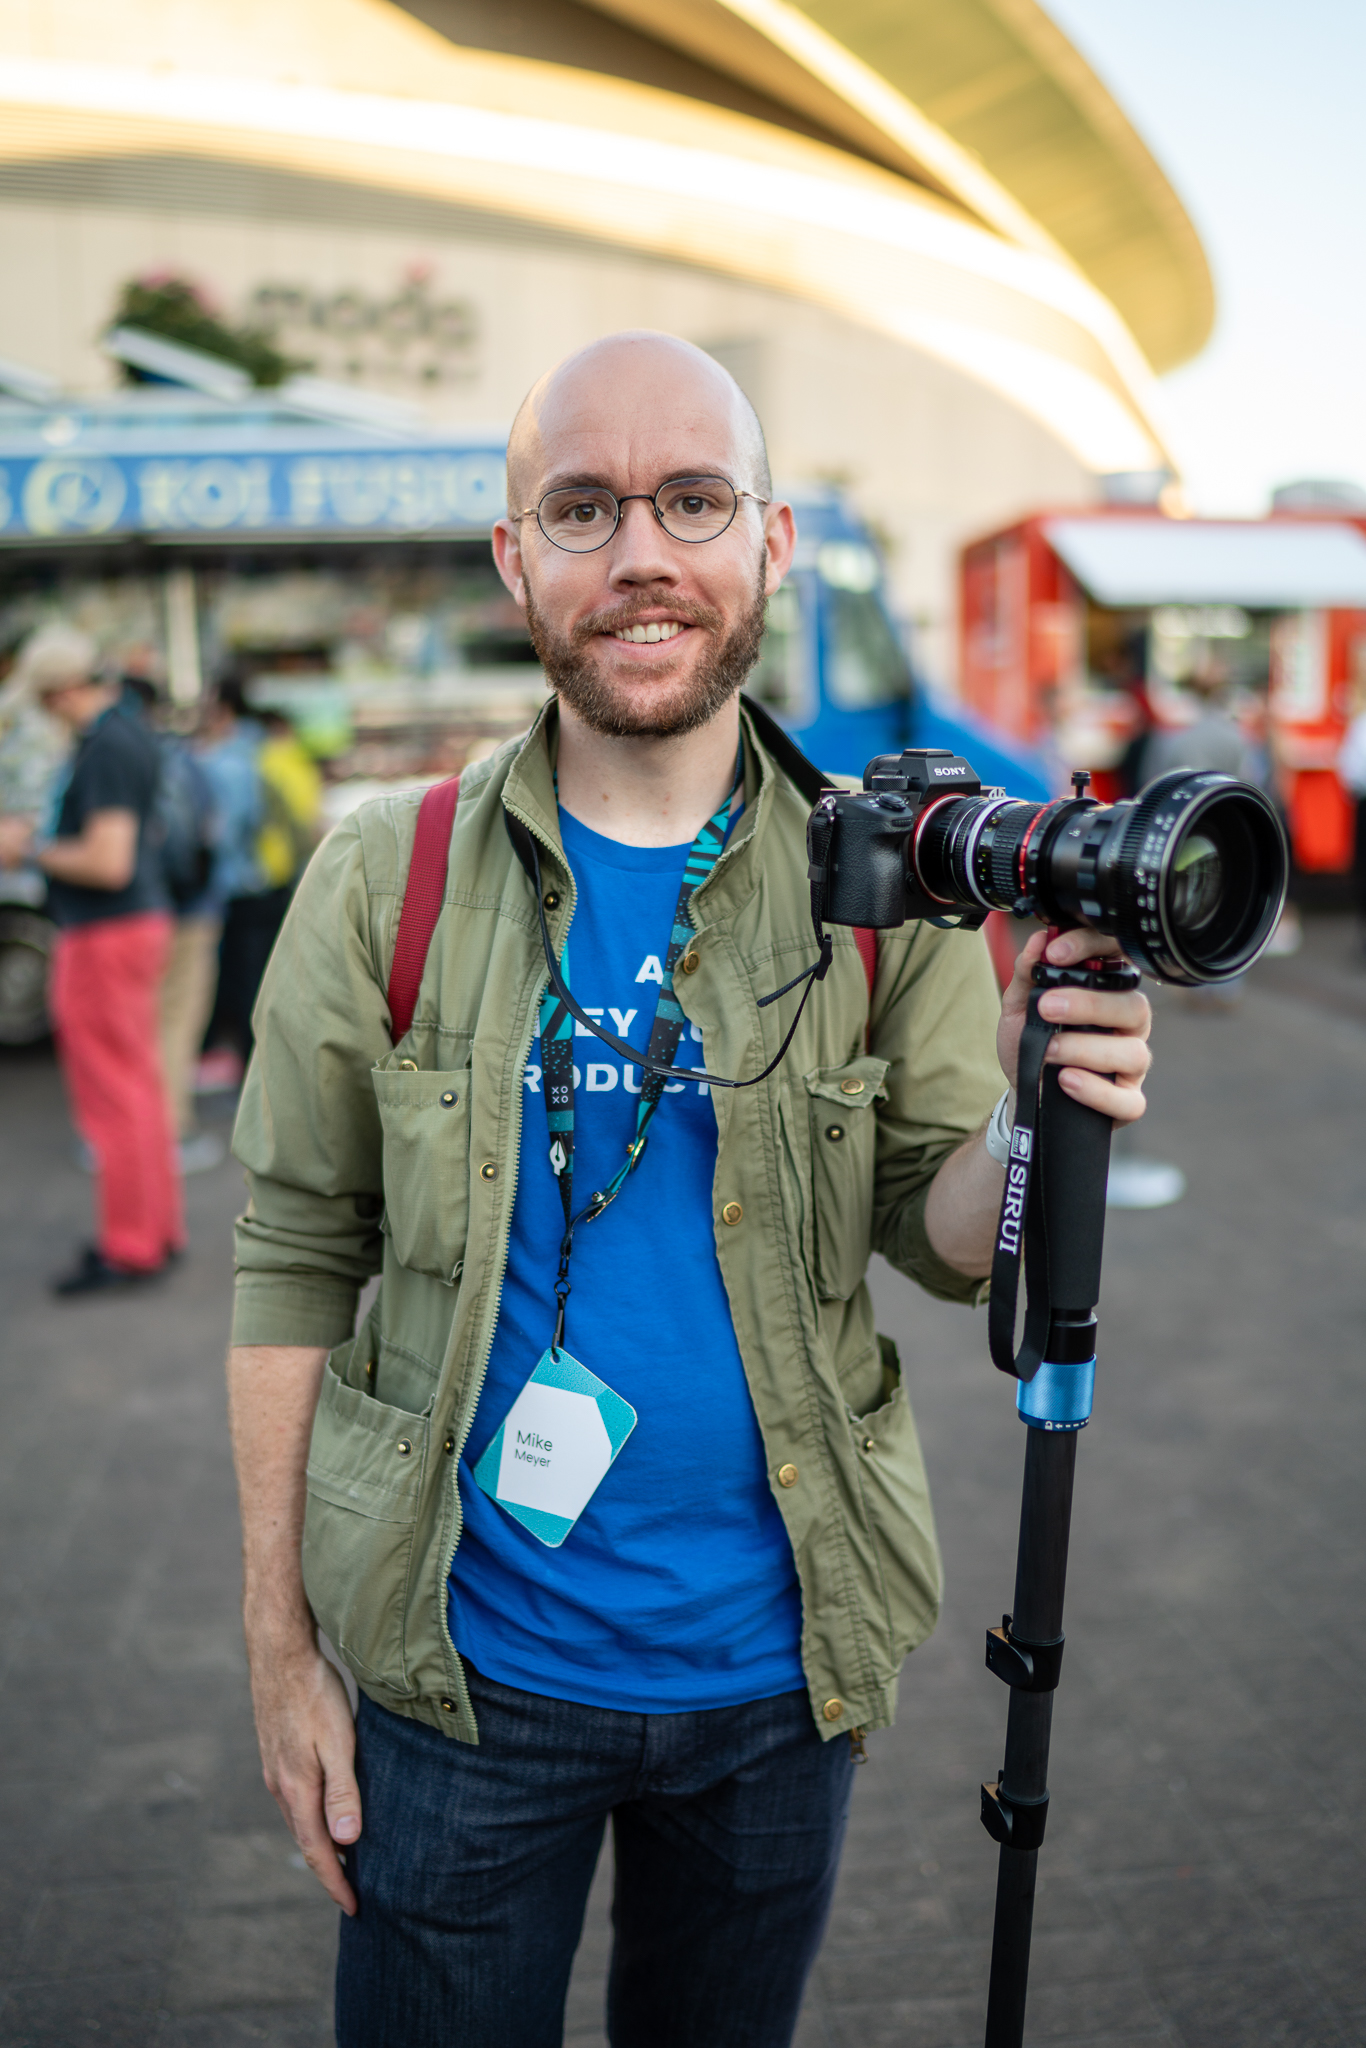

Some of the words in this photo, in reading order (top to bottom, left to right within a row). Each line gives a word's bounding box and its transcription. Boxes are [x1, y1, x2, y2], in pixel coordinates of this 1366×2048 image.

[934, 767, 966, 776] SONY
[635, 955, 664, 985] A
[533, 1008, 638, 1038] EY
[523, 1063, 709, 1097] RDU
[1000, 1164, 1027, 1255] SIRUI
[516, 1430, 553, 1451] Mike
[514, 1448, 551, 1468] Meyer
